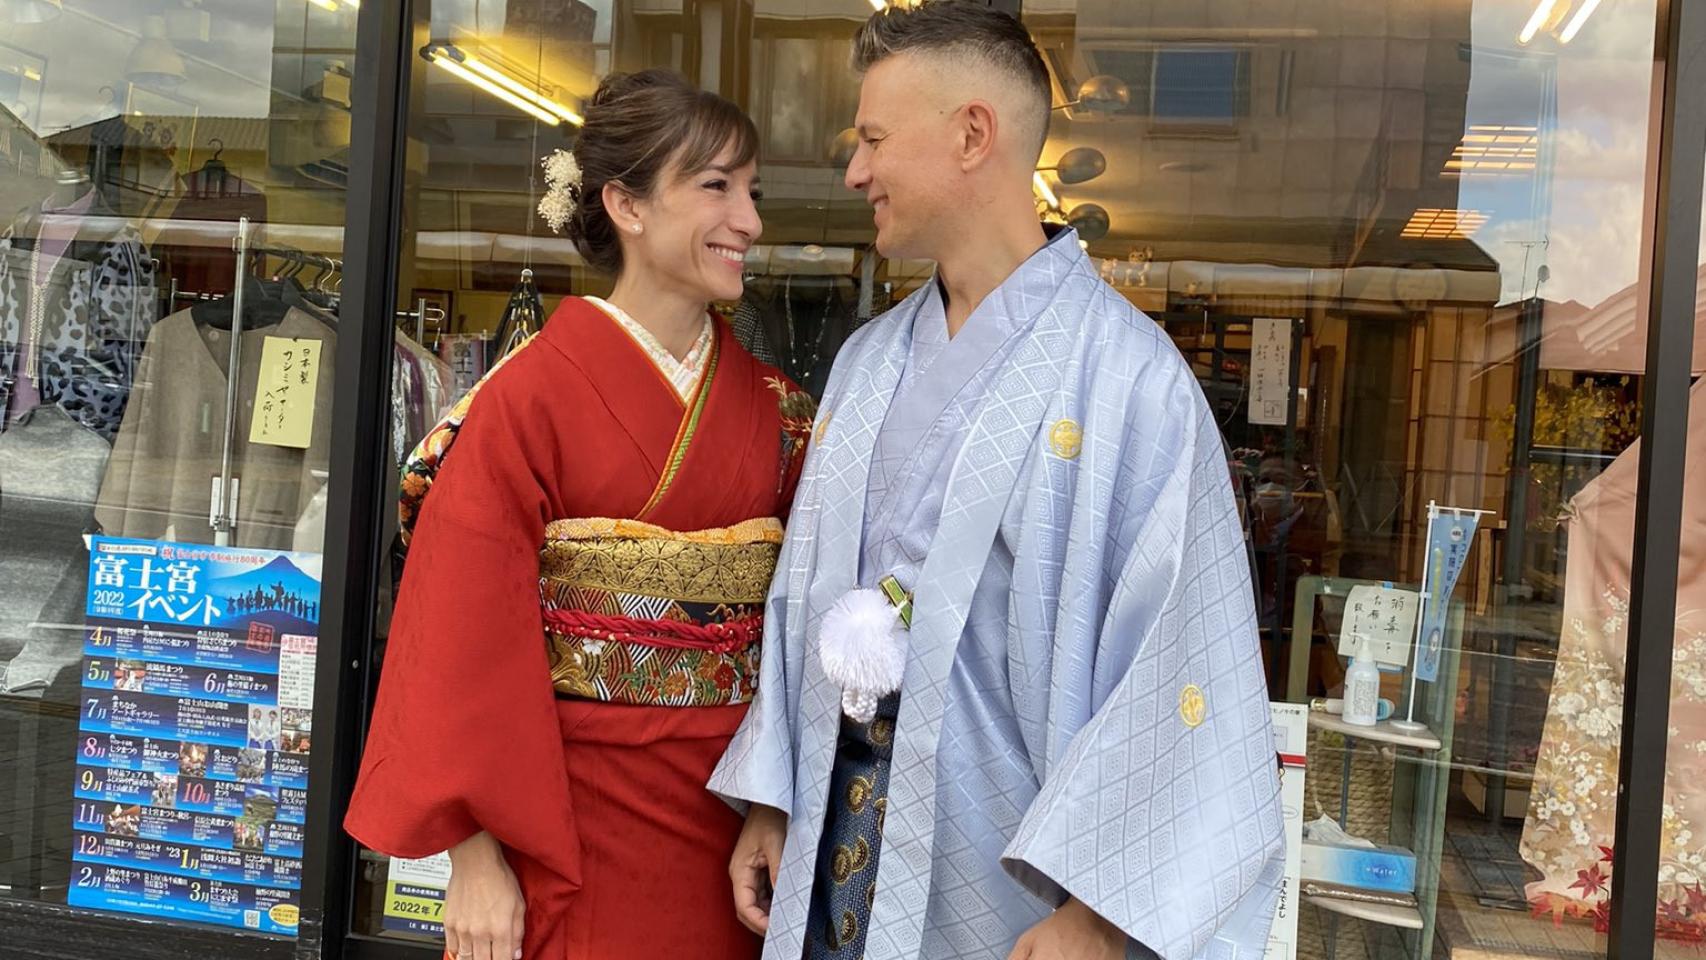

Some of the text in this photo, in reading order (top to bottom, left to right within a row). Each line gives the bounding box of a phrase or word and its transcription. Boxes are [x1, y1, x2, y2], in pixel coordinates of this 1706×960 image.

[94, 555, 201, 594] 富士宮
[93, 590, 125, 606] 2022
[127, 588, 222, 625] イベント
[89, 626, 112, 647] 4月
[88, 660, 110, 681] 5月
[204, 672, 225, 694] 6月
[87, 698, 107, 719] 7月
[112, 708, 160, 718] アートギャラリー
[84, 737, 106, 758] 8月
[81, 770, 103, 792] 9月
[182, 781, 211, 804] 10月
[78, 803, 105, 825] 11月
[78, 834, 105, 856] 12月
[180, 849, 199, 870] 1月
[78, 866, 101, 888] 2月
[189, 882, 210, 903] 3月
